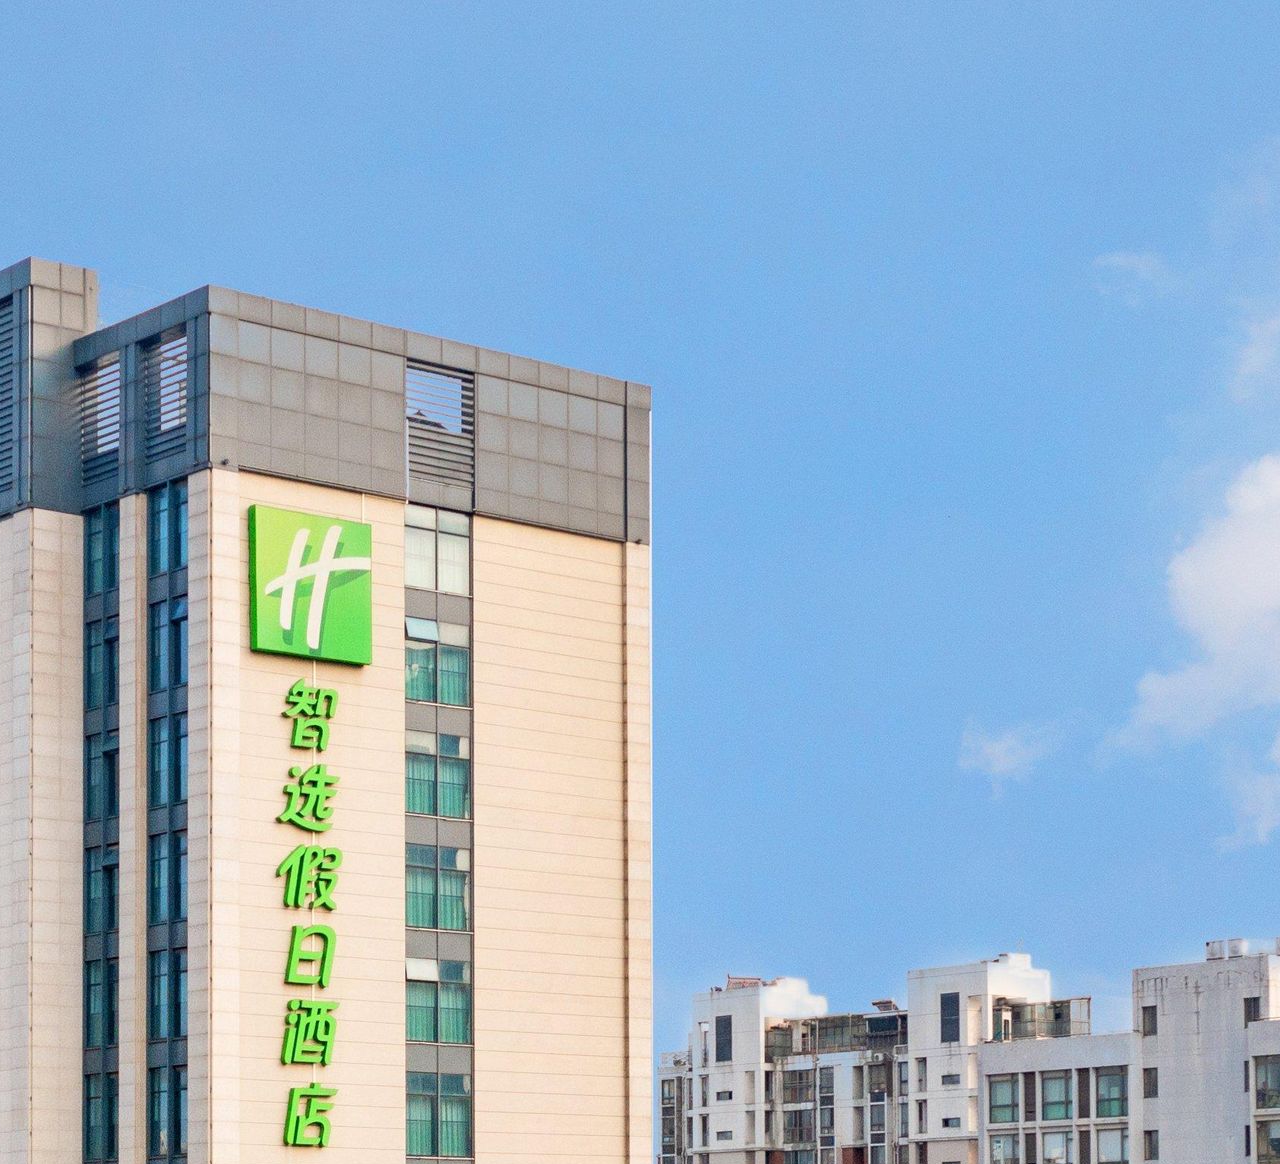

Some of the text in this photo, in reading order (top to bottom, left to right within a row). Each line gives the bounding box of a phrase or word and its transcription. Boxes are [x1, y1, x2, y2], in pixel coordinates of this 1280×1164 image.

[276, 677, 343, 1148] 智选假日酒店
